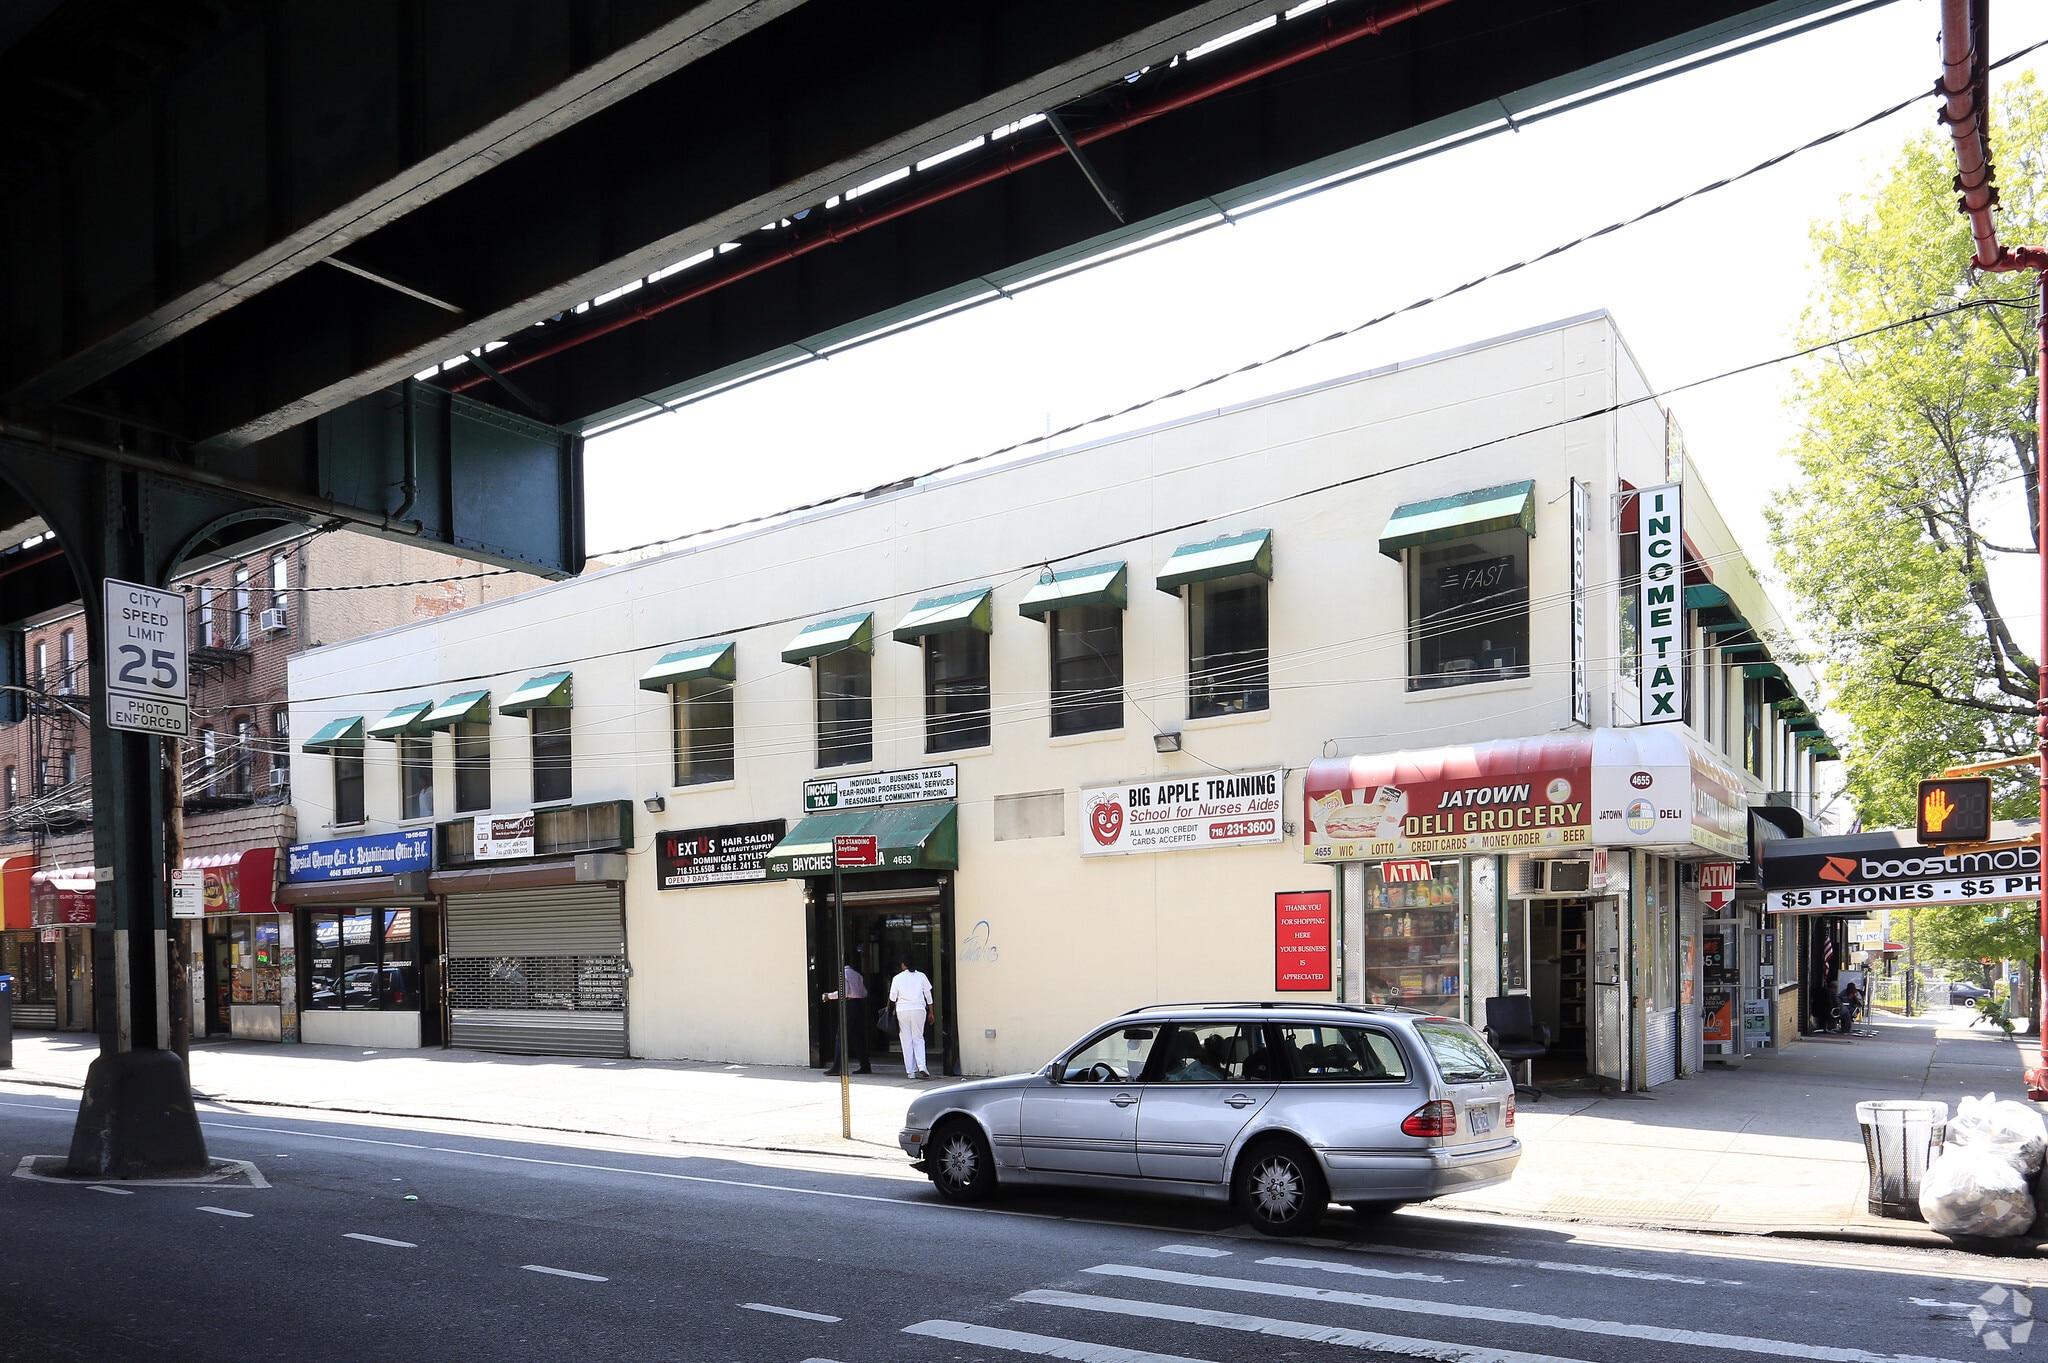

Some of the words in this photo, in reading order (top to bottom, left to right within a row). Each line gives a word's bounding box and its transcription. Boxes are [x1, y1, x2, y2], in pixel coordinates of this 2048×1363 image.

[1575, 490, 1583, 626] INCOME
[1647, 494, 1675, 628] INCOME
[1462, 563, 1509, 589] FAST
[129, 592, 161, 608] CITY
[122, 607, 169, 627] SPEED
[128, 625, 165, 643] LIMIT
[118, 644, 178, 689] 25
[1576, 634, 1584, 715] TAX
[1651, 636, 1676, 716] TAX
[128, 700, 169, 716] PHOTO
[115, 711, 181, 730] ENFORCED
[849, 777, 882, 787] INDIVIDUAL
[889, 773, 919, 783] BUSINESS
[921, 770, 942, 779] TAXES
[1631, 775, 1651, 786] 4655
[807, 783, 837, 796] INCOME
[838, 787, 876, 797] YEAR-ROUND
[878, 782, 922, 793] PROFESSIONAL
[924, 778, 955, 788] SERVICES
[1128, 788, 1151, 808] BIG
[1157, 782, 1200, 805] APPLE
[1207, 774, 1276, 800] TRAINING
[813, 795, 830, 807] TAX
[844, 795, 883, 806] REASONABLE
[884, 791, 920, 802] COMMUNITY
[922, 788, 948, 798] PRICING
[1437, 784, 1531, 810] JATOWN
[1129, 806, 1171, 822] School
[1176, 804, 1194, 817] for
[1198, 802, 1242, 816] Nurses
[1247, 798, 1280, 812] Aides
[1599, 810, 1623, 820] JATOWN
[1659, 809, 1682, 819] DELI
[1405, 813, 1454, 837] DELI
[1462, 801, 1583, 832] GROCERY
[1129, 829, 1143, 837] ALL
[1145, 826, 1171, 836] MAJOR
[1173, 824, 1199, 834] CREDIT
[1211, 820, 1273, 838] 718/231-3600
[666, 836, 715, 858] NEXTUS
[721, 837, 743, 847] HAIR
[744, 833, 775, 845] SALON
[750, 843, 772, 851] SUPPLY
[1131, 837, 1156, 846] CARDS
[1158, 833, 1197, 844] ACCEPTED
[1314, 847, 1332, 857] 4655
[1339, 845, 1354, 857] WIC
[1371, 842, 1394, 855] LOTTO
[1411, 839, 1439, 853] CREDIT
[1440, 837, 1467, 851] CARDS
[1481, 834, 1510, 848] MONEY
[1512, 832, 1540, 846] ORDER
[1563, 829, 1585, 842] BEER
[837, 845, 859, 853] Anytime
[289, 853, 312, 875] Physical
[311, 850, 334, 870] Therapy
[333, 848, 348, 867] Care
[348, 848, 355, 865] &
[356, 845, 395, 866] Rehabilitation
[395, 841, 413, 862] Office
[693, 855, 737, 865] DOMINICAN
[792, 856, 834, 872] BAYCHES
[892, 855, 912, 865] 4653
[1594, 851, 1607, 875] ATM
[329, 867, 341, 877] 4645
[342, 866, 373, 876] WHITEPLAINS
[374, 865, 383, 873] RD.
[676, 866, 716, 876] 718.515.6508
[720, 863, 732, 872] 686
[732, 862, 739, 871] E.
[740, 861, 752, 870] 241
[752, 860, 761, 869] ST.
[771, 863, 789, 873] 4653
[1389, 863, 1429, 883] ATM
[667, 876, 686, 885] OPEN
[686, 875, 691, 883] 7
[692, 874, 710, 883] DAYS
[1701, 866, 1733, 888] ATM
[174, 889, 182, 897] 2
[1781, 891, 1812, 908] $5
[1820, 883, 1934, 906] PHONES
[1960, 879, 1995, 898] $5
[1285, 904, 1308, 912] THANK
[1293, 917, 1326, 925] SHOPPING
[1294, 931, 1312, 939] HERE
[1280, 945, 1298, 953] YOUR
[0, 982, 7, 991] P
